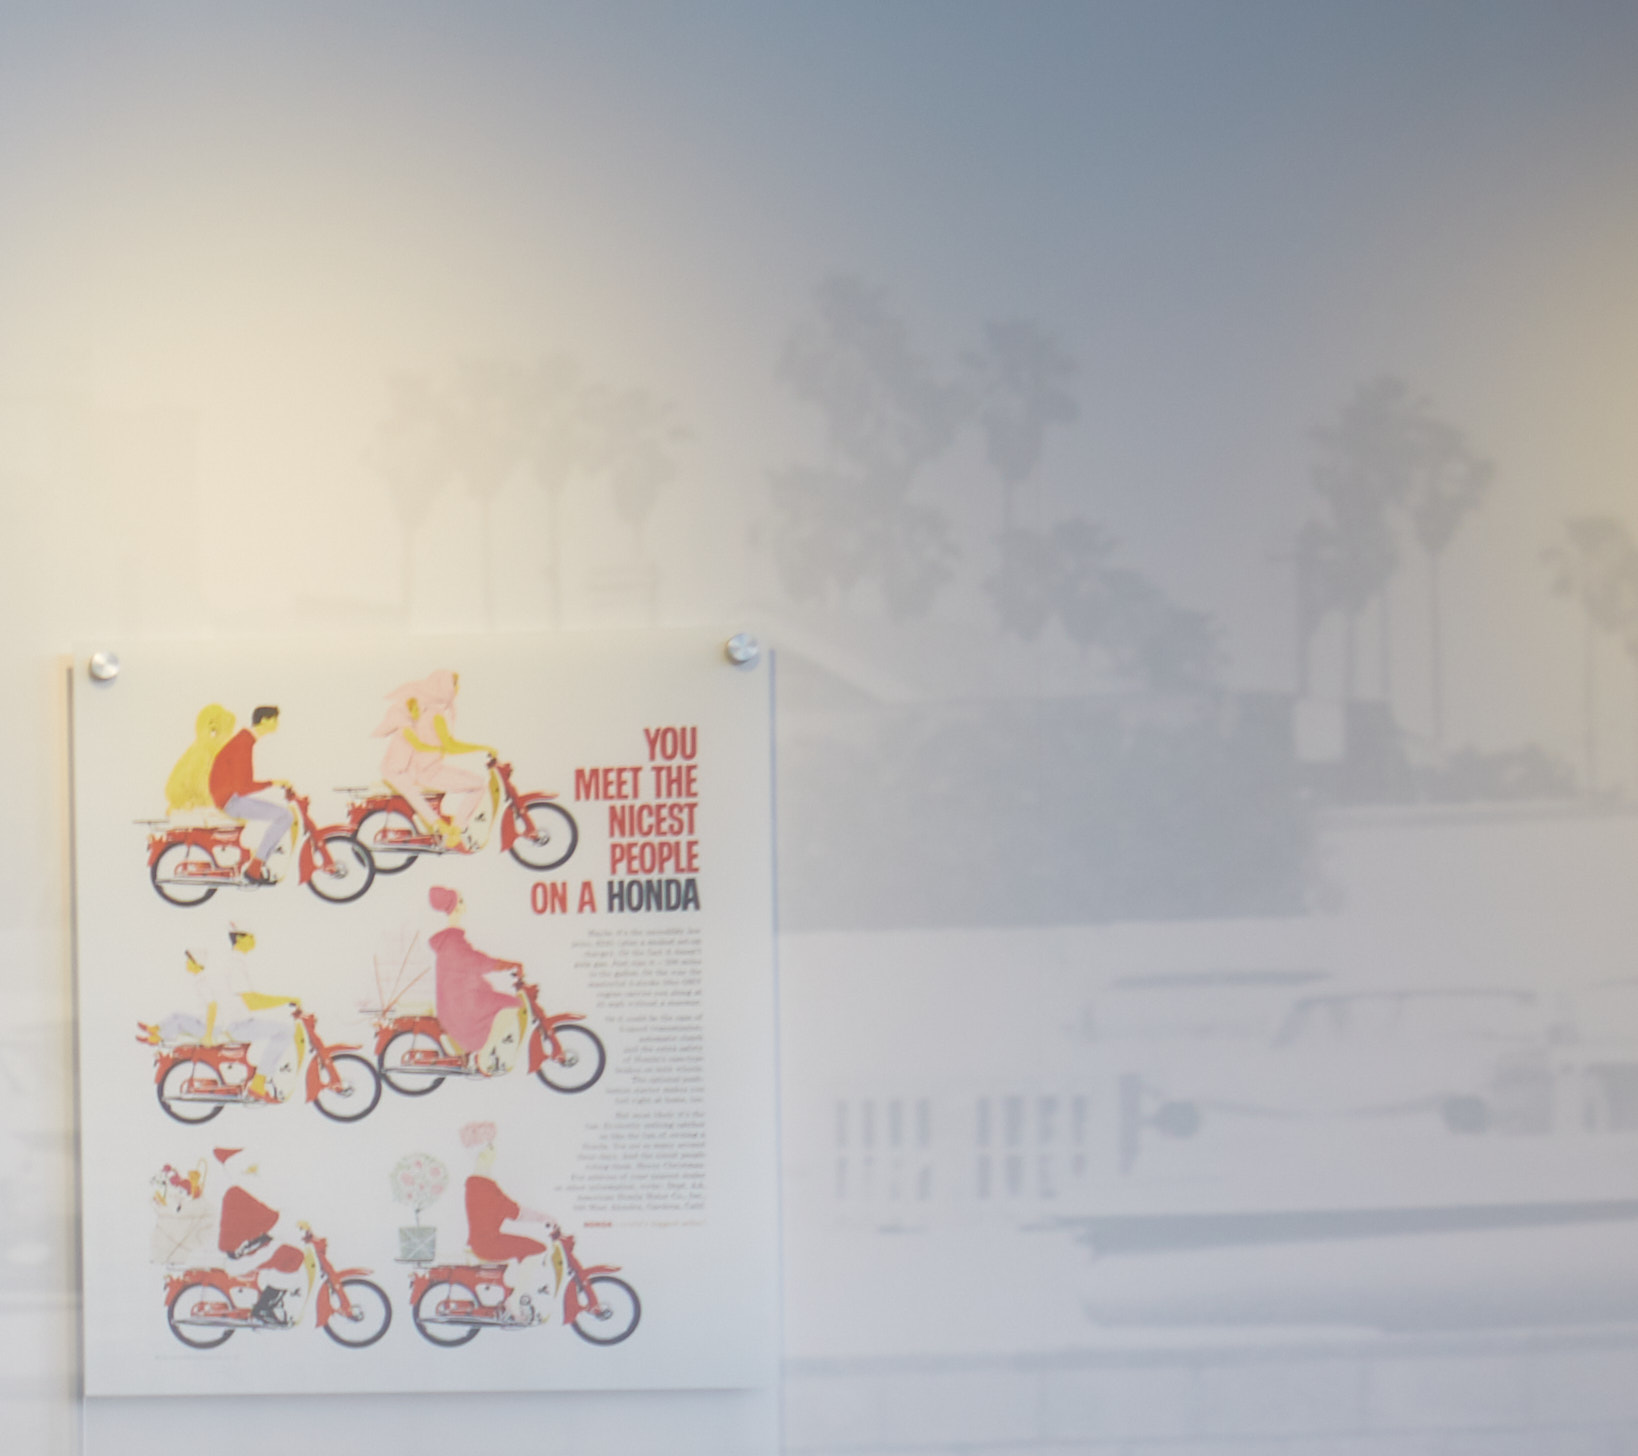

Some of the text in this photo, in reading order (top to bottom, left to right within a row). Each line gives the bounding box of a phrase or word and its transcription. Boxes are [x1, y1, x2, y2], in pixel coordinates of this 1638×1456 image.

[644, 726, 697, 761] YOU
[575, 764, 698, 801] MEET THE
[609, 803, 698, 837] NICEST
[610, 840, 700, 875] PEOPLE
[531, 878, 701, 914] ON A HONDA
